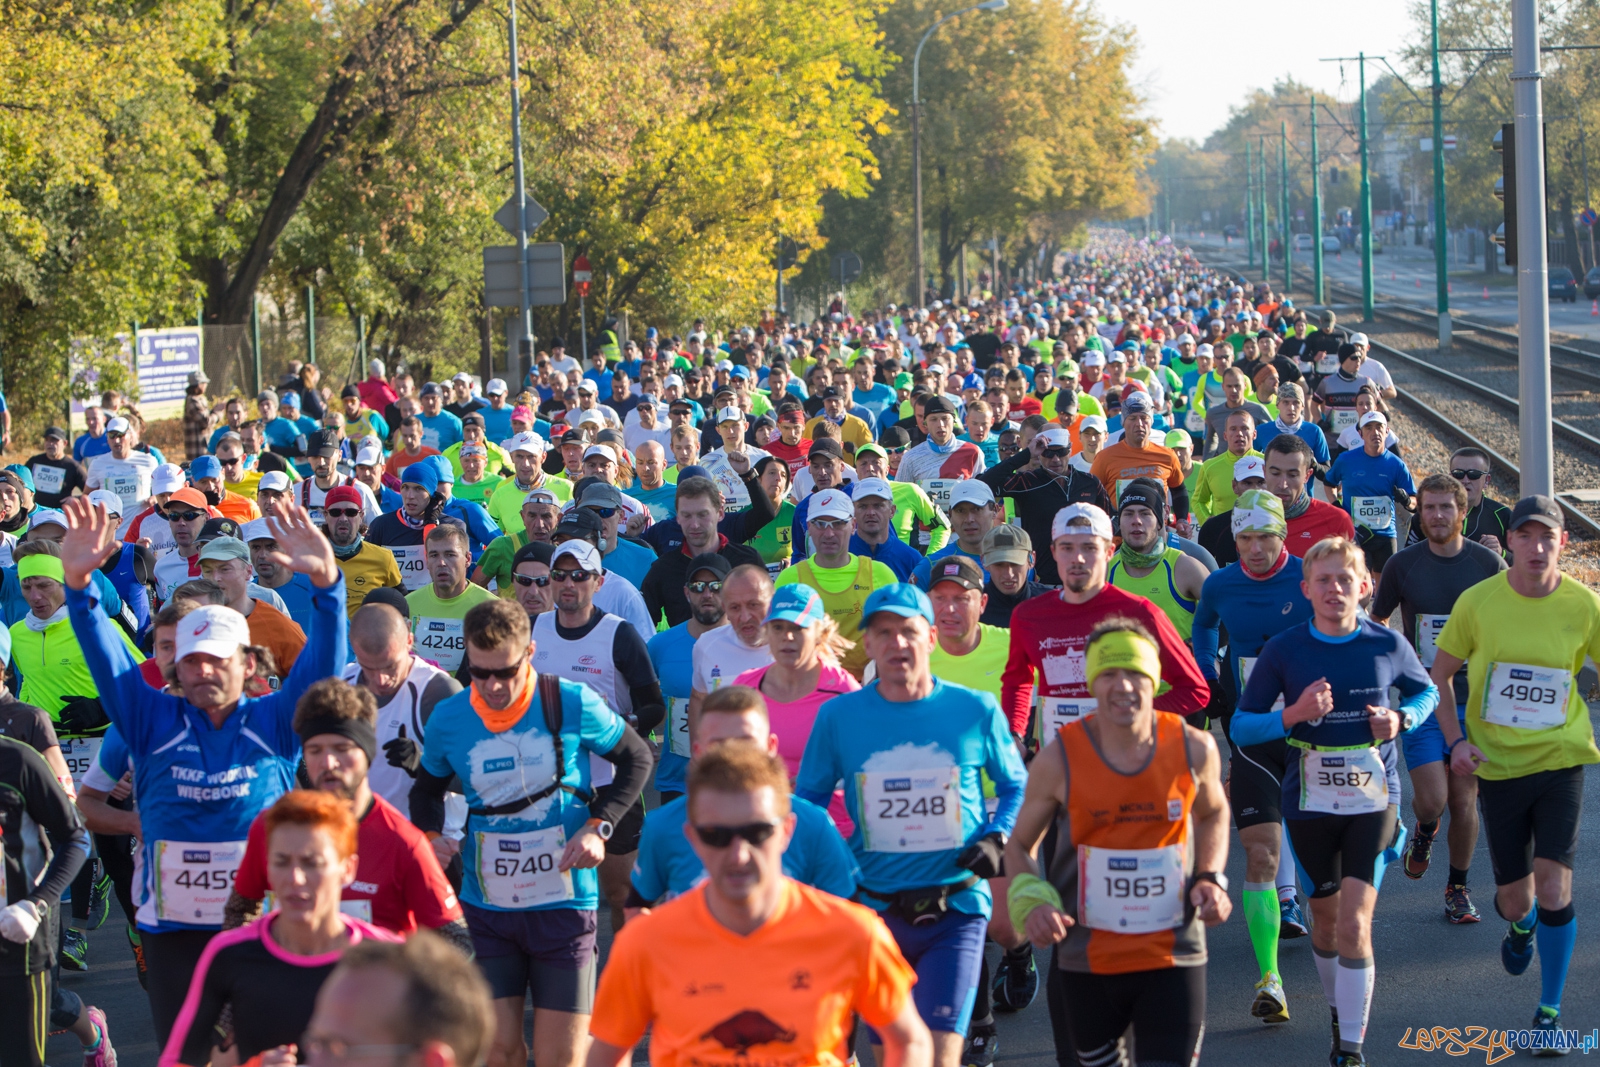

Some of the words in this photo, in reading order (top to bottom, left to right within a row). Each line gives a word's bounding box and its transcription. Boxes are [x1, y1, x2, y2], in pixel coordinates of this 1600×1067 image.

[37, 472, 59, 483] 5269
[1120, 466, 1156, 477] CRAFT
[114, 484, 137, 494] 1289
[1359, 507, 1387, 516] 6034
[151, 541, 178, 551] Wielis
[421, 634, 466, 650] 4248
[1500, 684, 1557, 704] 4903
[171, 765, 206, 783] TKKF
[1317, 771, 1373, 787] 3687
[177, 782, 250, 803] WIĘCBORK
[877, 795, 946, 818] 2248
[494, 853, 553, 877] 6740
[1103, 875, 1165, 898] 1963
